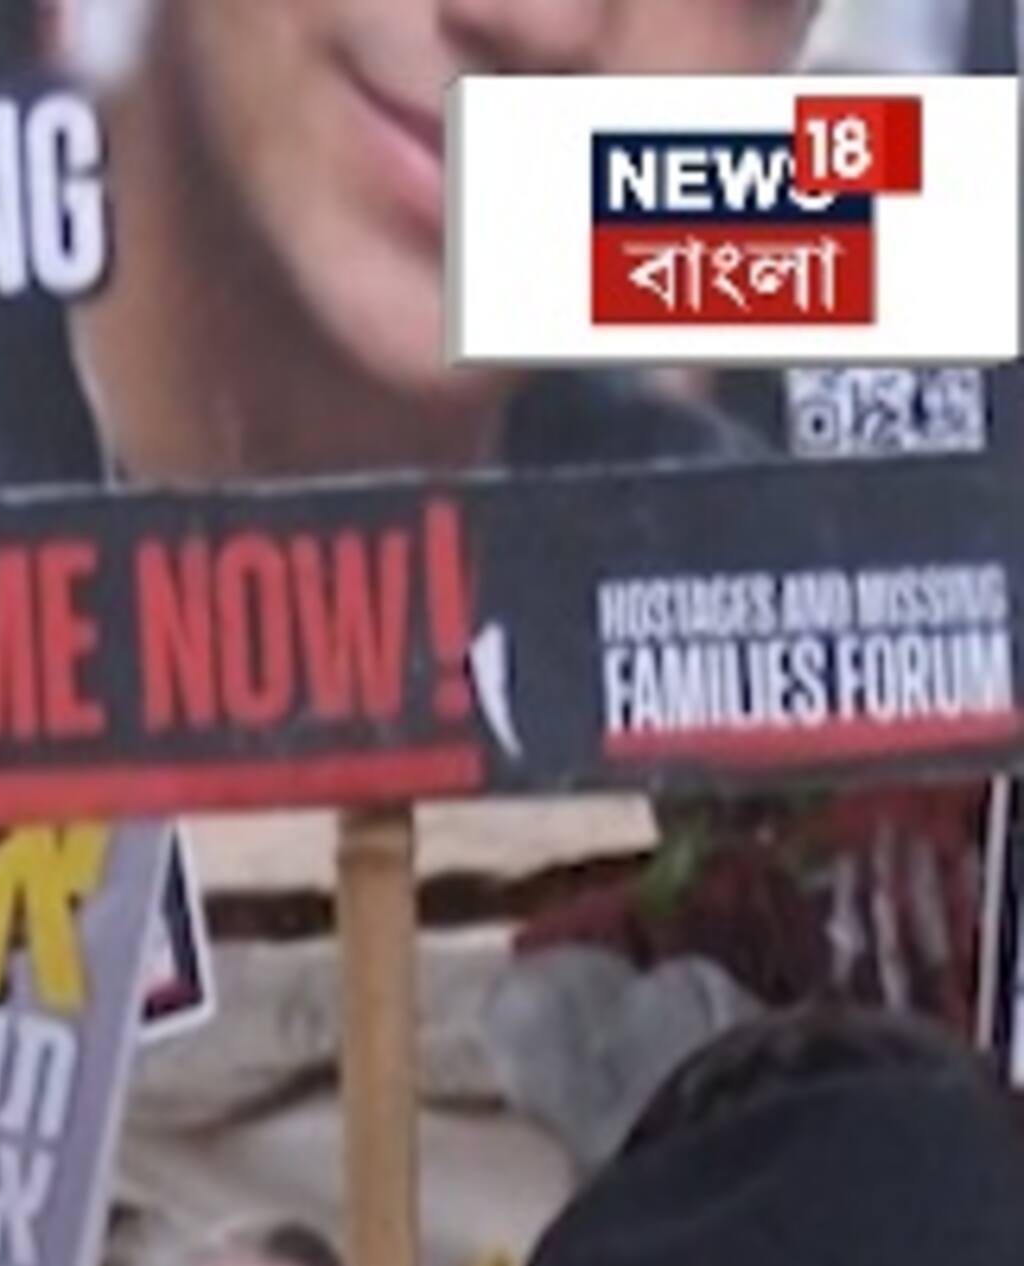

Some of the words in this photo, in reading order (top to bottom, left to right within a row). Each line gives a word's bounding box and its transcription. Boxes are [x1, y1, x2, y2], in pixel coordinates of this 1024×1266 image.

[135, 496, 473, 731] NOW!
[597, 573, 774, 641] HOSTAGES
[780, 568, 852, 634] AND
[856, 563, 1008, 629] MISSING
[603, 634, 830, 732] FAMILIES
[834, 628, 1014, 721] FORUM
